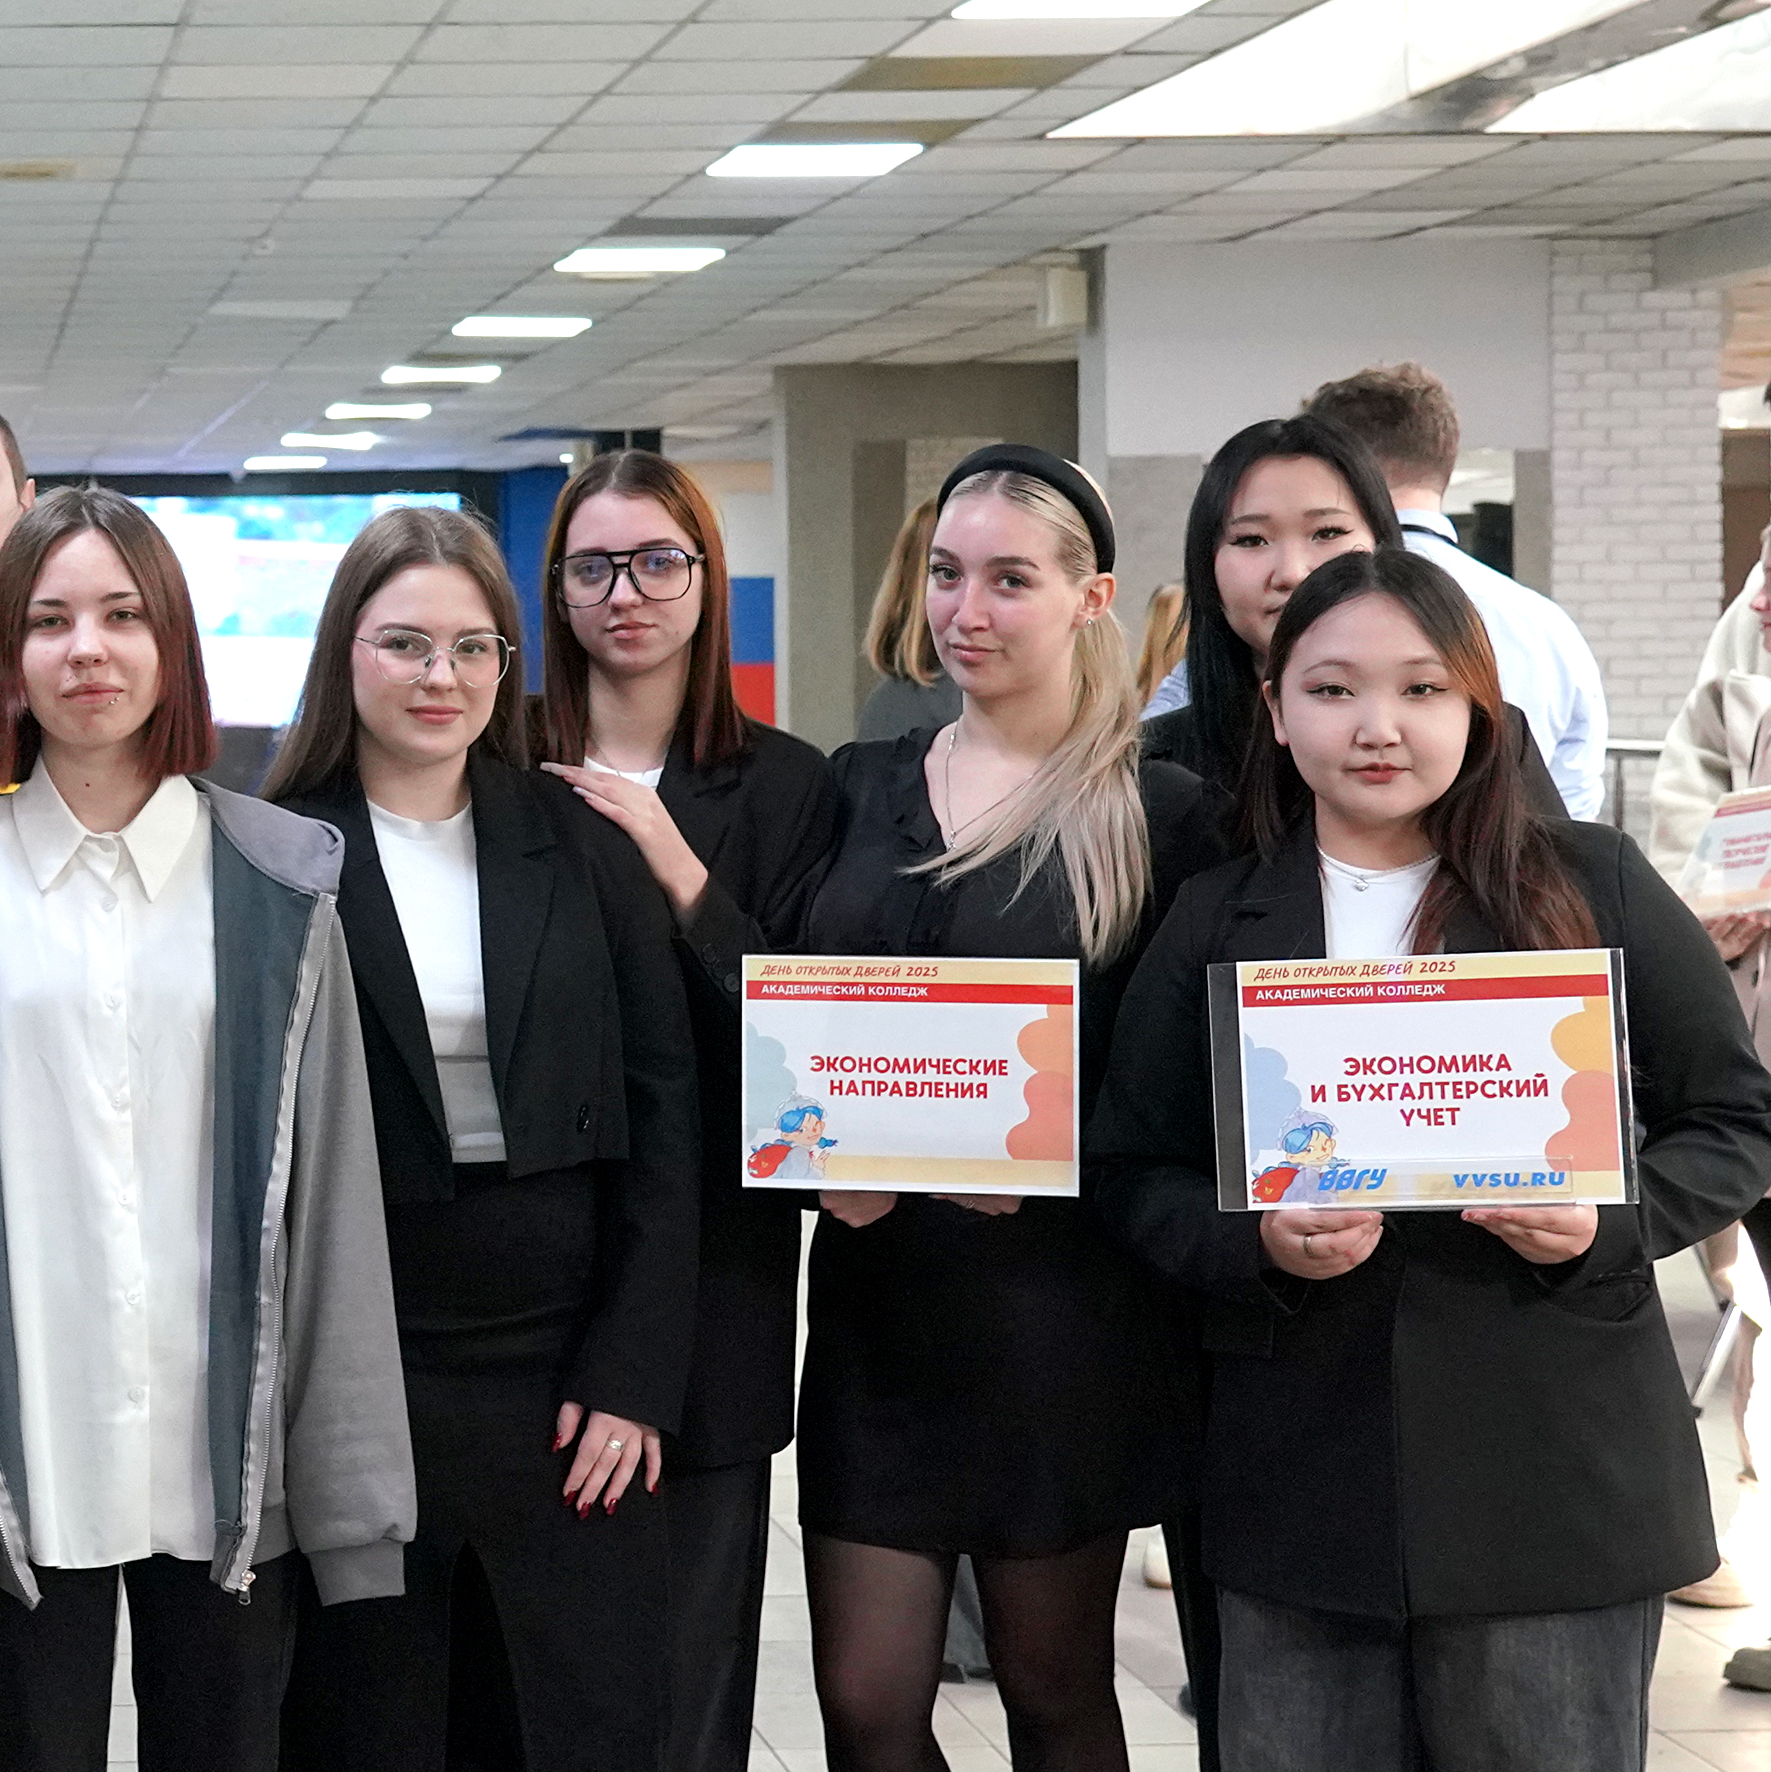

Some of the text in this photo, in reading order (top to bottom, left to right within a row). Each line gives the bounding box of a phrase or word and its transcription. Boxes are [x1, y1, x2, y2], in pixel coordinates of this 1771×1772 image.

[760, 963, 939, 979] ДЕНЬ ОТКРЫТЫХ ДВЕРЕЙ 2025
[1253, 960, 1457, 982] ДЕНЬ ОТКРЫТЫХ ДВЕРЕЙ 2025
[761, 982, 929, 998] АКАДЕМИЧЕСКИЙ КОЛЛЕДЖ
[1255, 983, 1446, 1001] АКАДЕМИЧЕСКИЙ КОЛЛЕДЖ
[809, 1055, 1009, 1077] ЭКОНОМИЧЕСКИЕ
[1343, 1053, 1513, 1077] ЭКОНОМИКА
[829, 1080, 988, 1099] НАПРАВЛЕНИЯ
[1310, 1072, 1550, 1103] И БУХГАЛТЕРСКИЙ
[1399, 1107, 1462, 1127] УЧЕТ
[1317, 1167, 1389, 1192] ВВГУ
[1453, 1170, 1566, 1189] VVSU.RU
